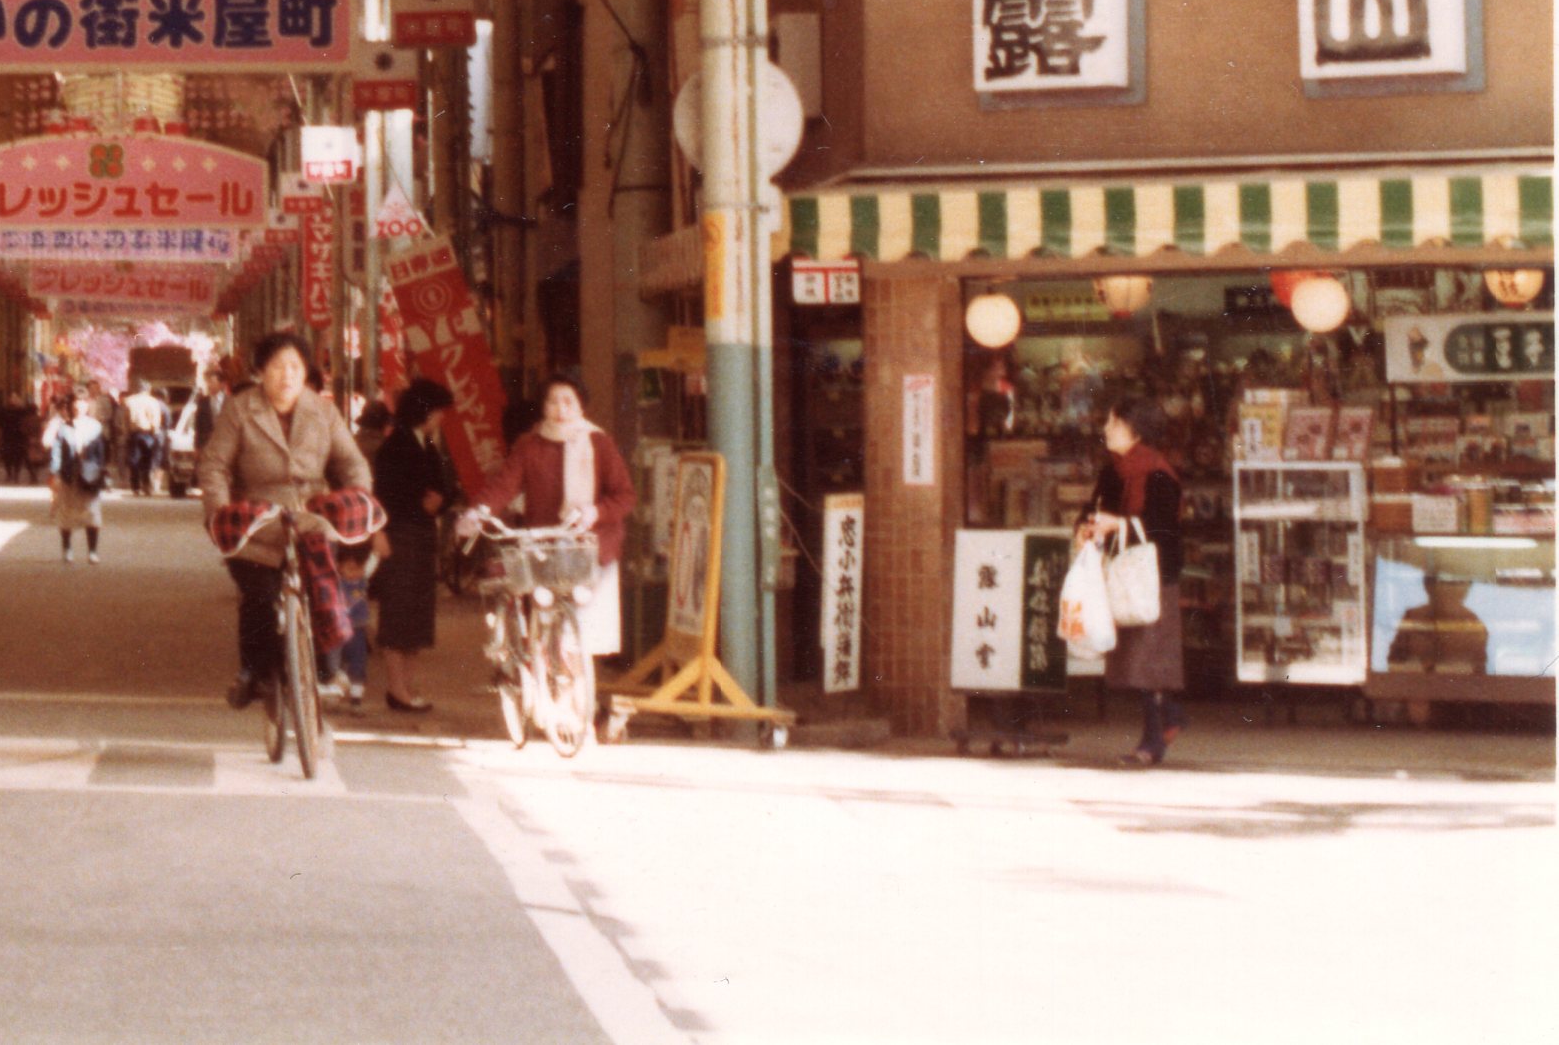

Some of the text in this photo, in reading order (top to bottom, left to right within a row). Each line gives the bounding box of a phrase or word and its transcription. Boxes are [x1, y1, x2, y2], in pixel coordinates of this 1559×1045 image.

[310, 207, 332, 321] マザキパン
